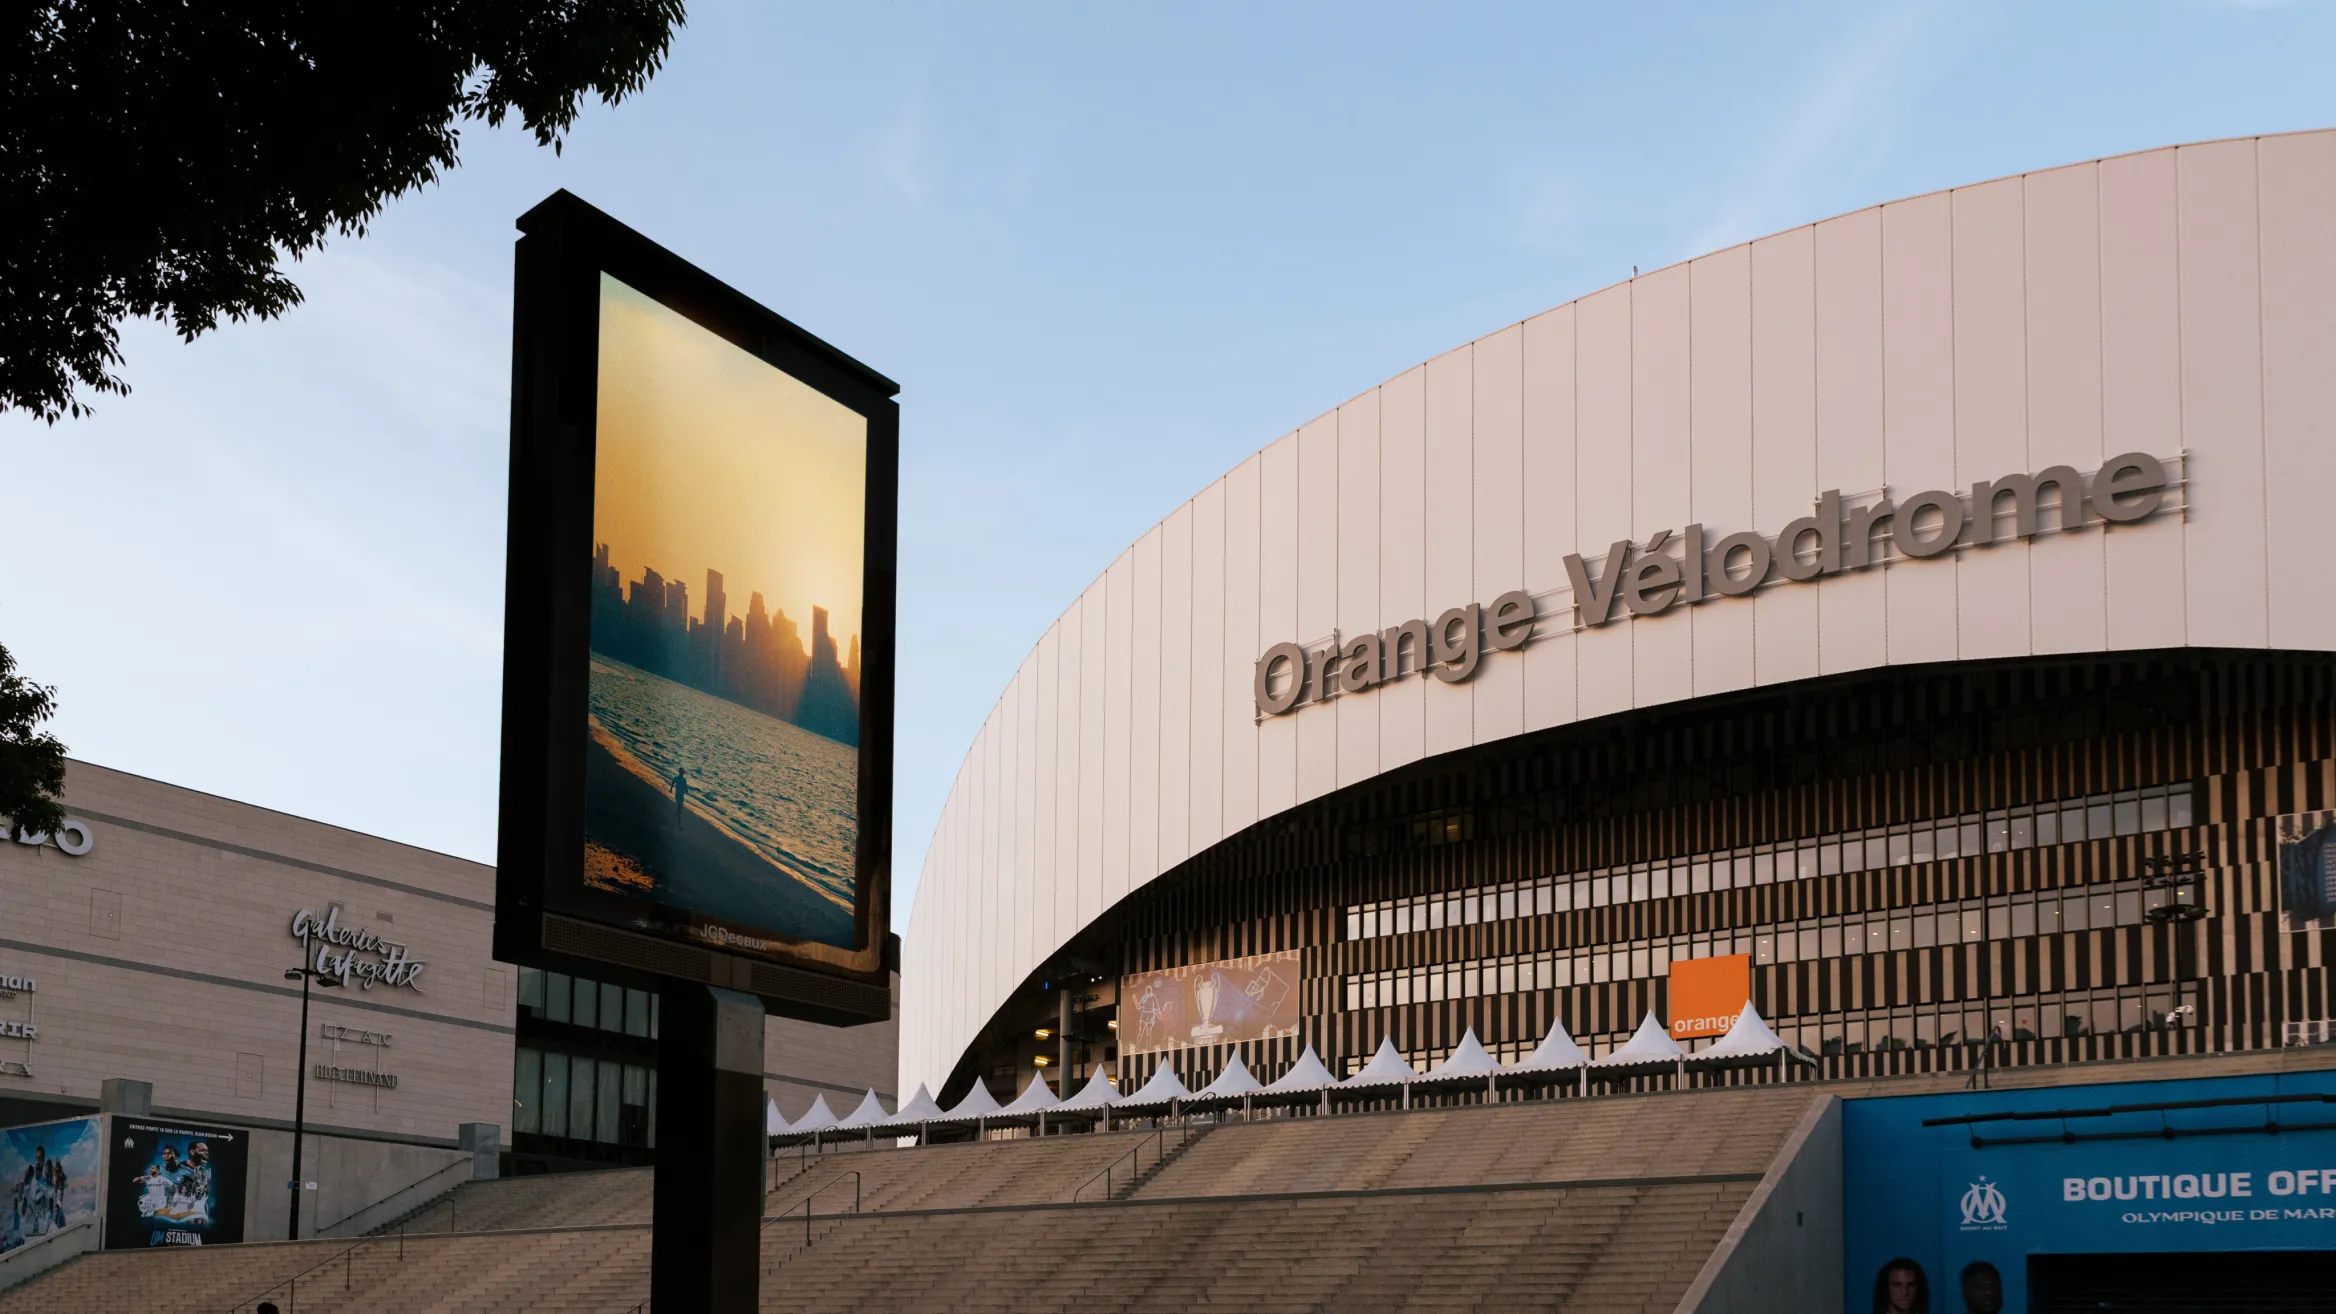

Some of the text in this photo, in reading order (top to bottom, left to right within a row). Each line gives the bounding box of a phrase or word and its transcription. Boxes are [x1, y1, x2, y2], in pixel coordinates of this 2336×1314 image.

[1254, 452, 2167, 715] Orange Vélodrome
[292, 906, 388, 954] Galeries
[316, 944, 428, 992] Lafayette
[2063, 1169, 2336, 1201] BOUTIQUE OFF
[2122, 1208, 2336, 1225] OLYMPIQUE DE MAR
[165, 1231, 202, 1246] STADIUM
